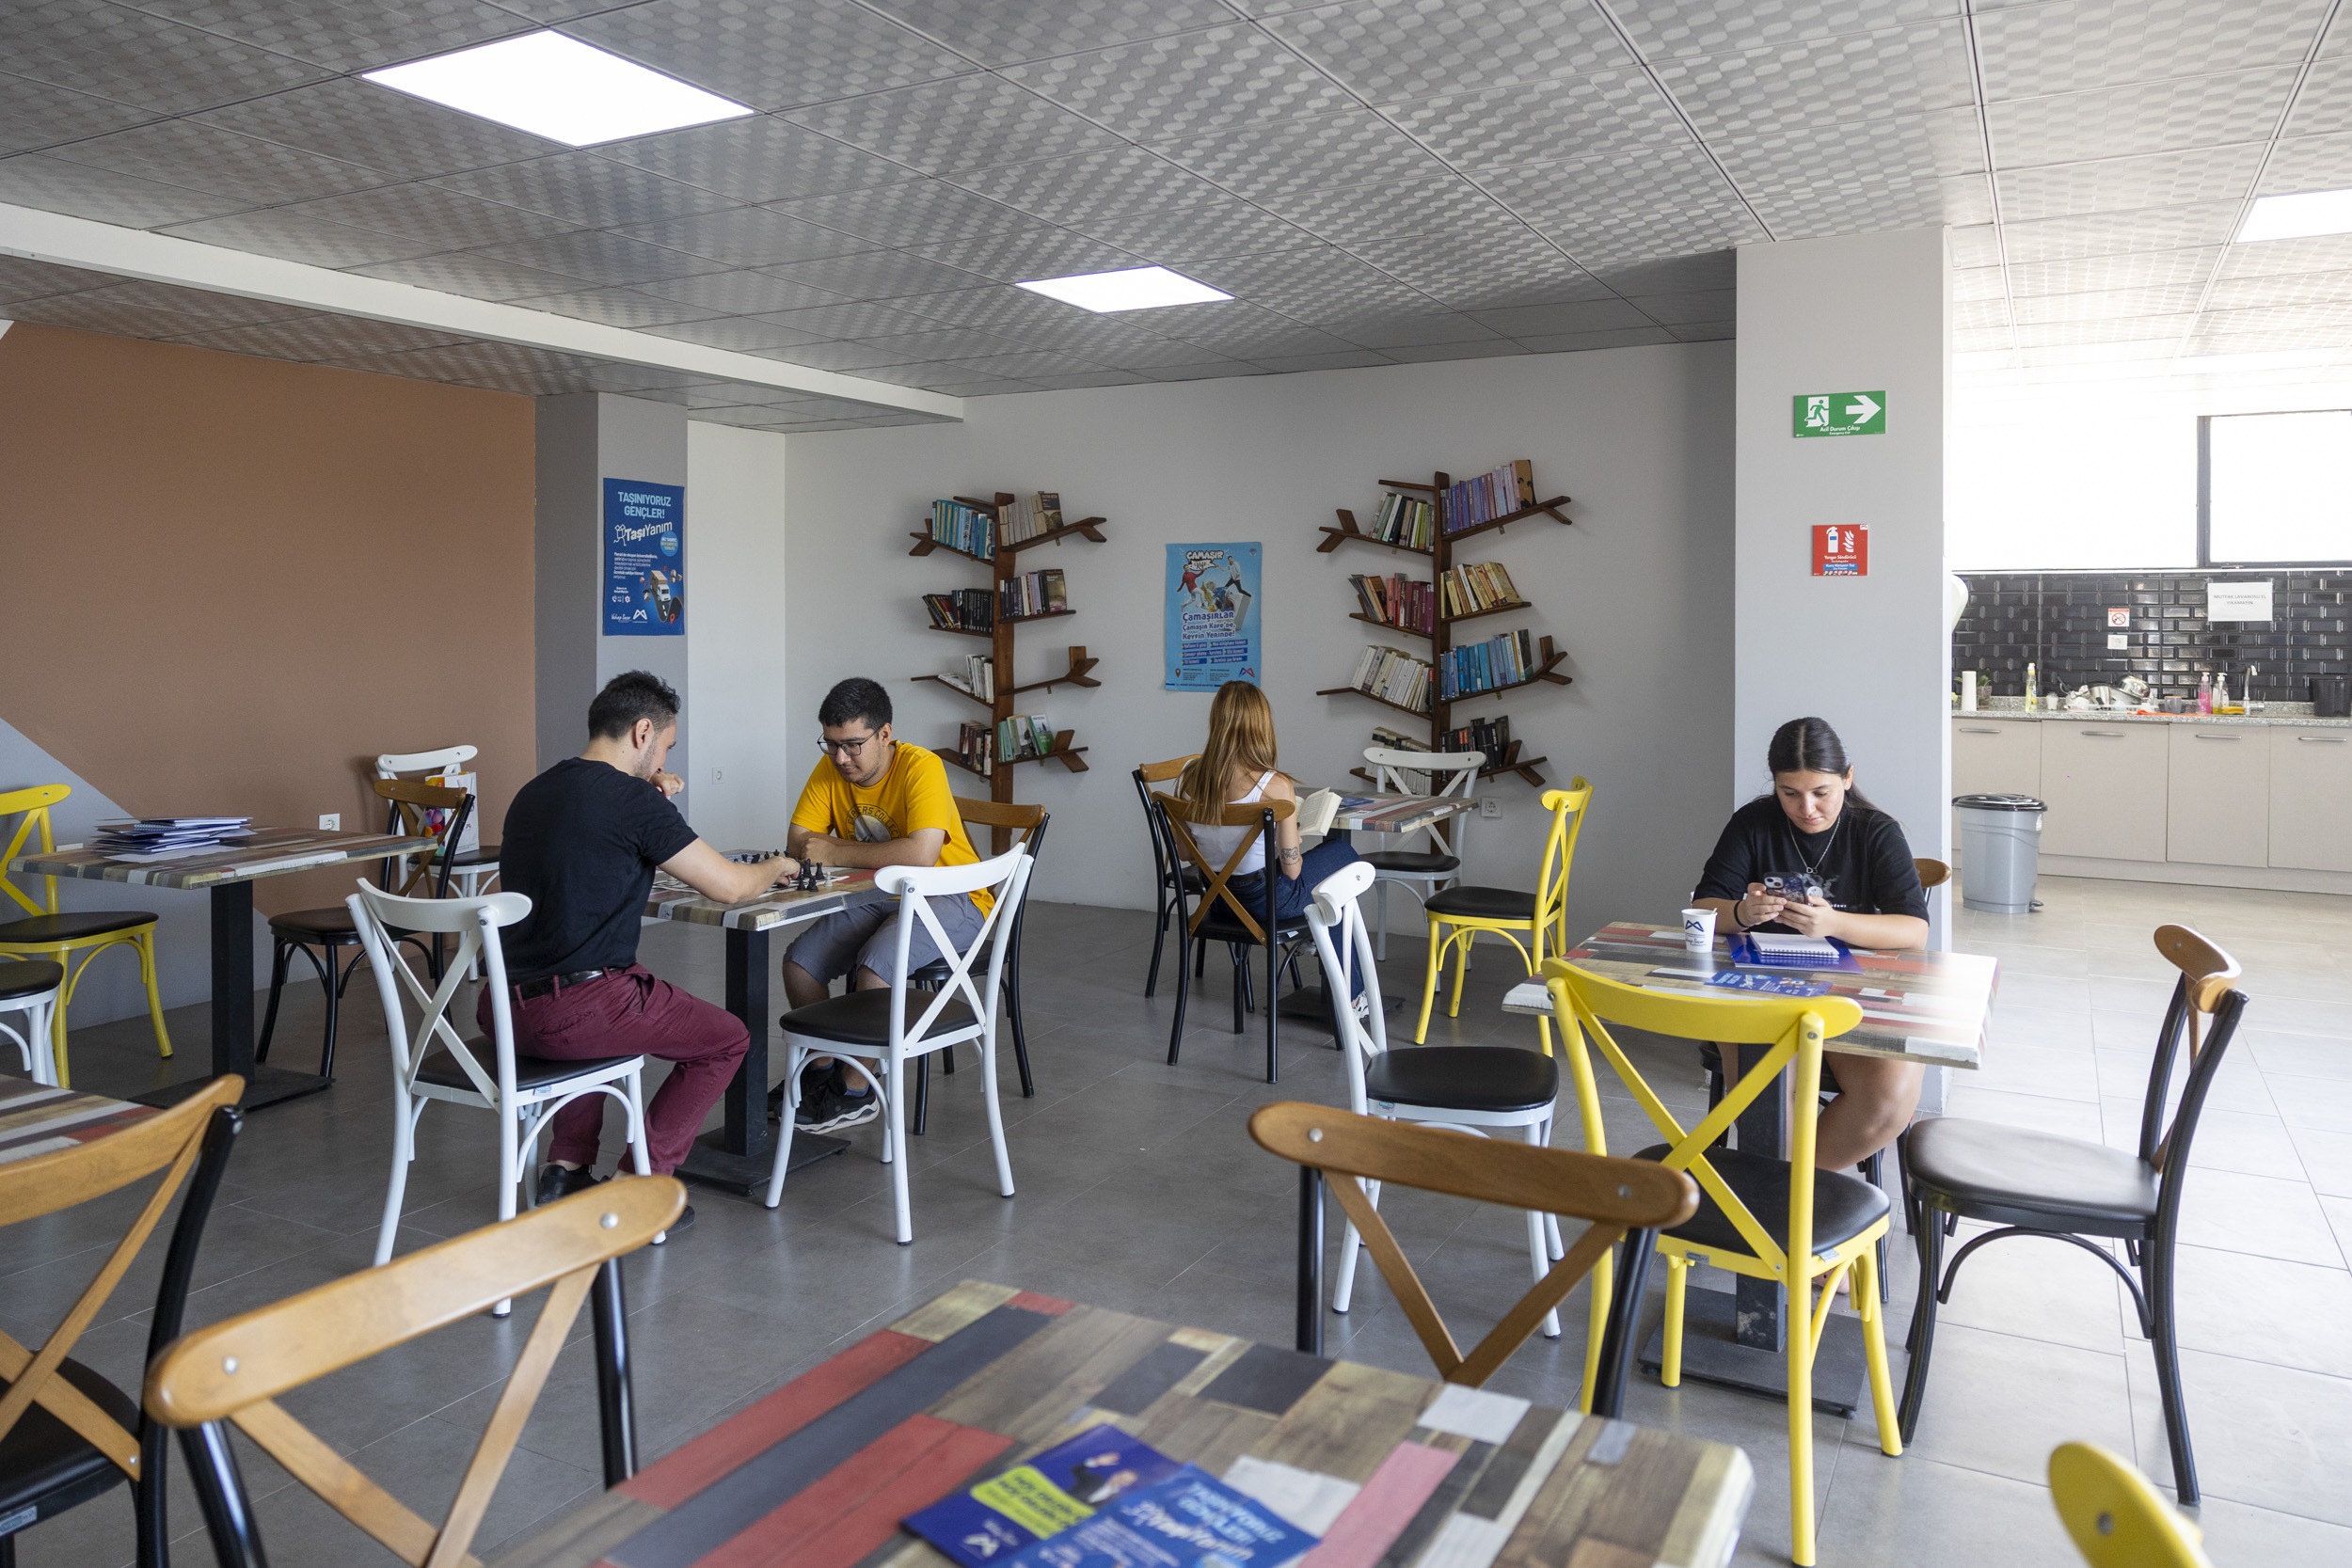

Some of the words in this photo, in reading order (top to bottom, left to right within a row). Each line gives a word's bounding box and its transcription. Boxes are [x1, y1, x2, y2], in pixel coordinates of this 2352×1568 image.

[617, 491, 671, 507] TAŞINIYORUZ
[624, 505, 665, 519] GENÇLER!
[625, 521, 673, 541] TaşıYanım
[1186, 550, 1224, 562] ÇAMAŞIR
